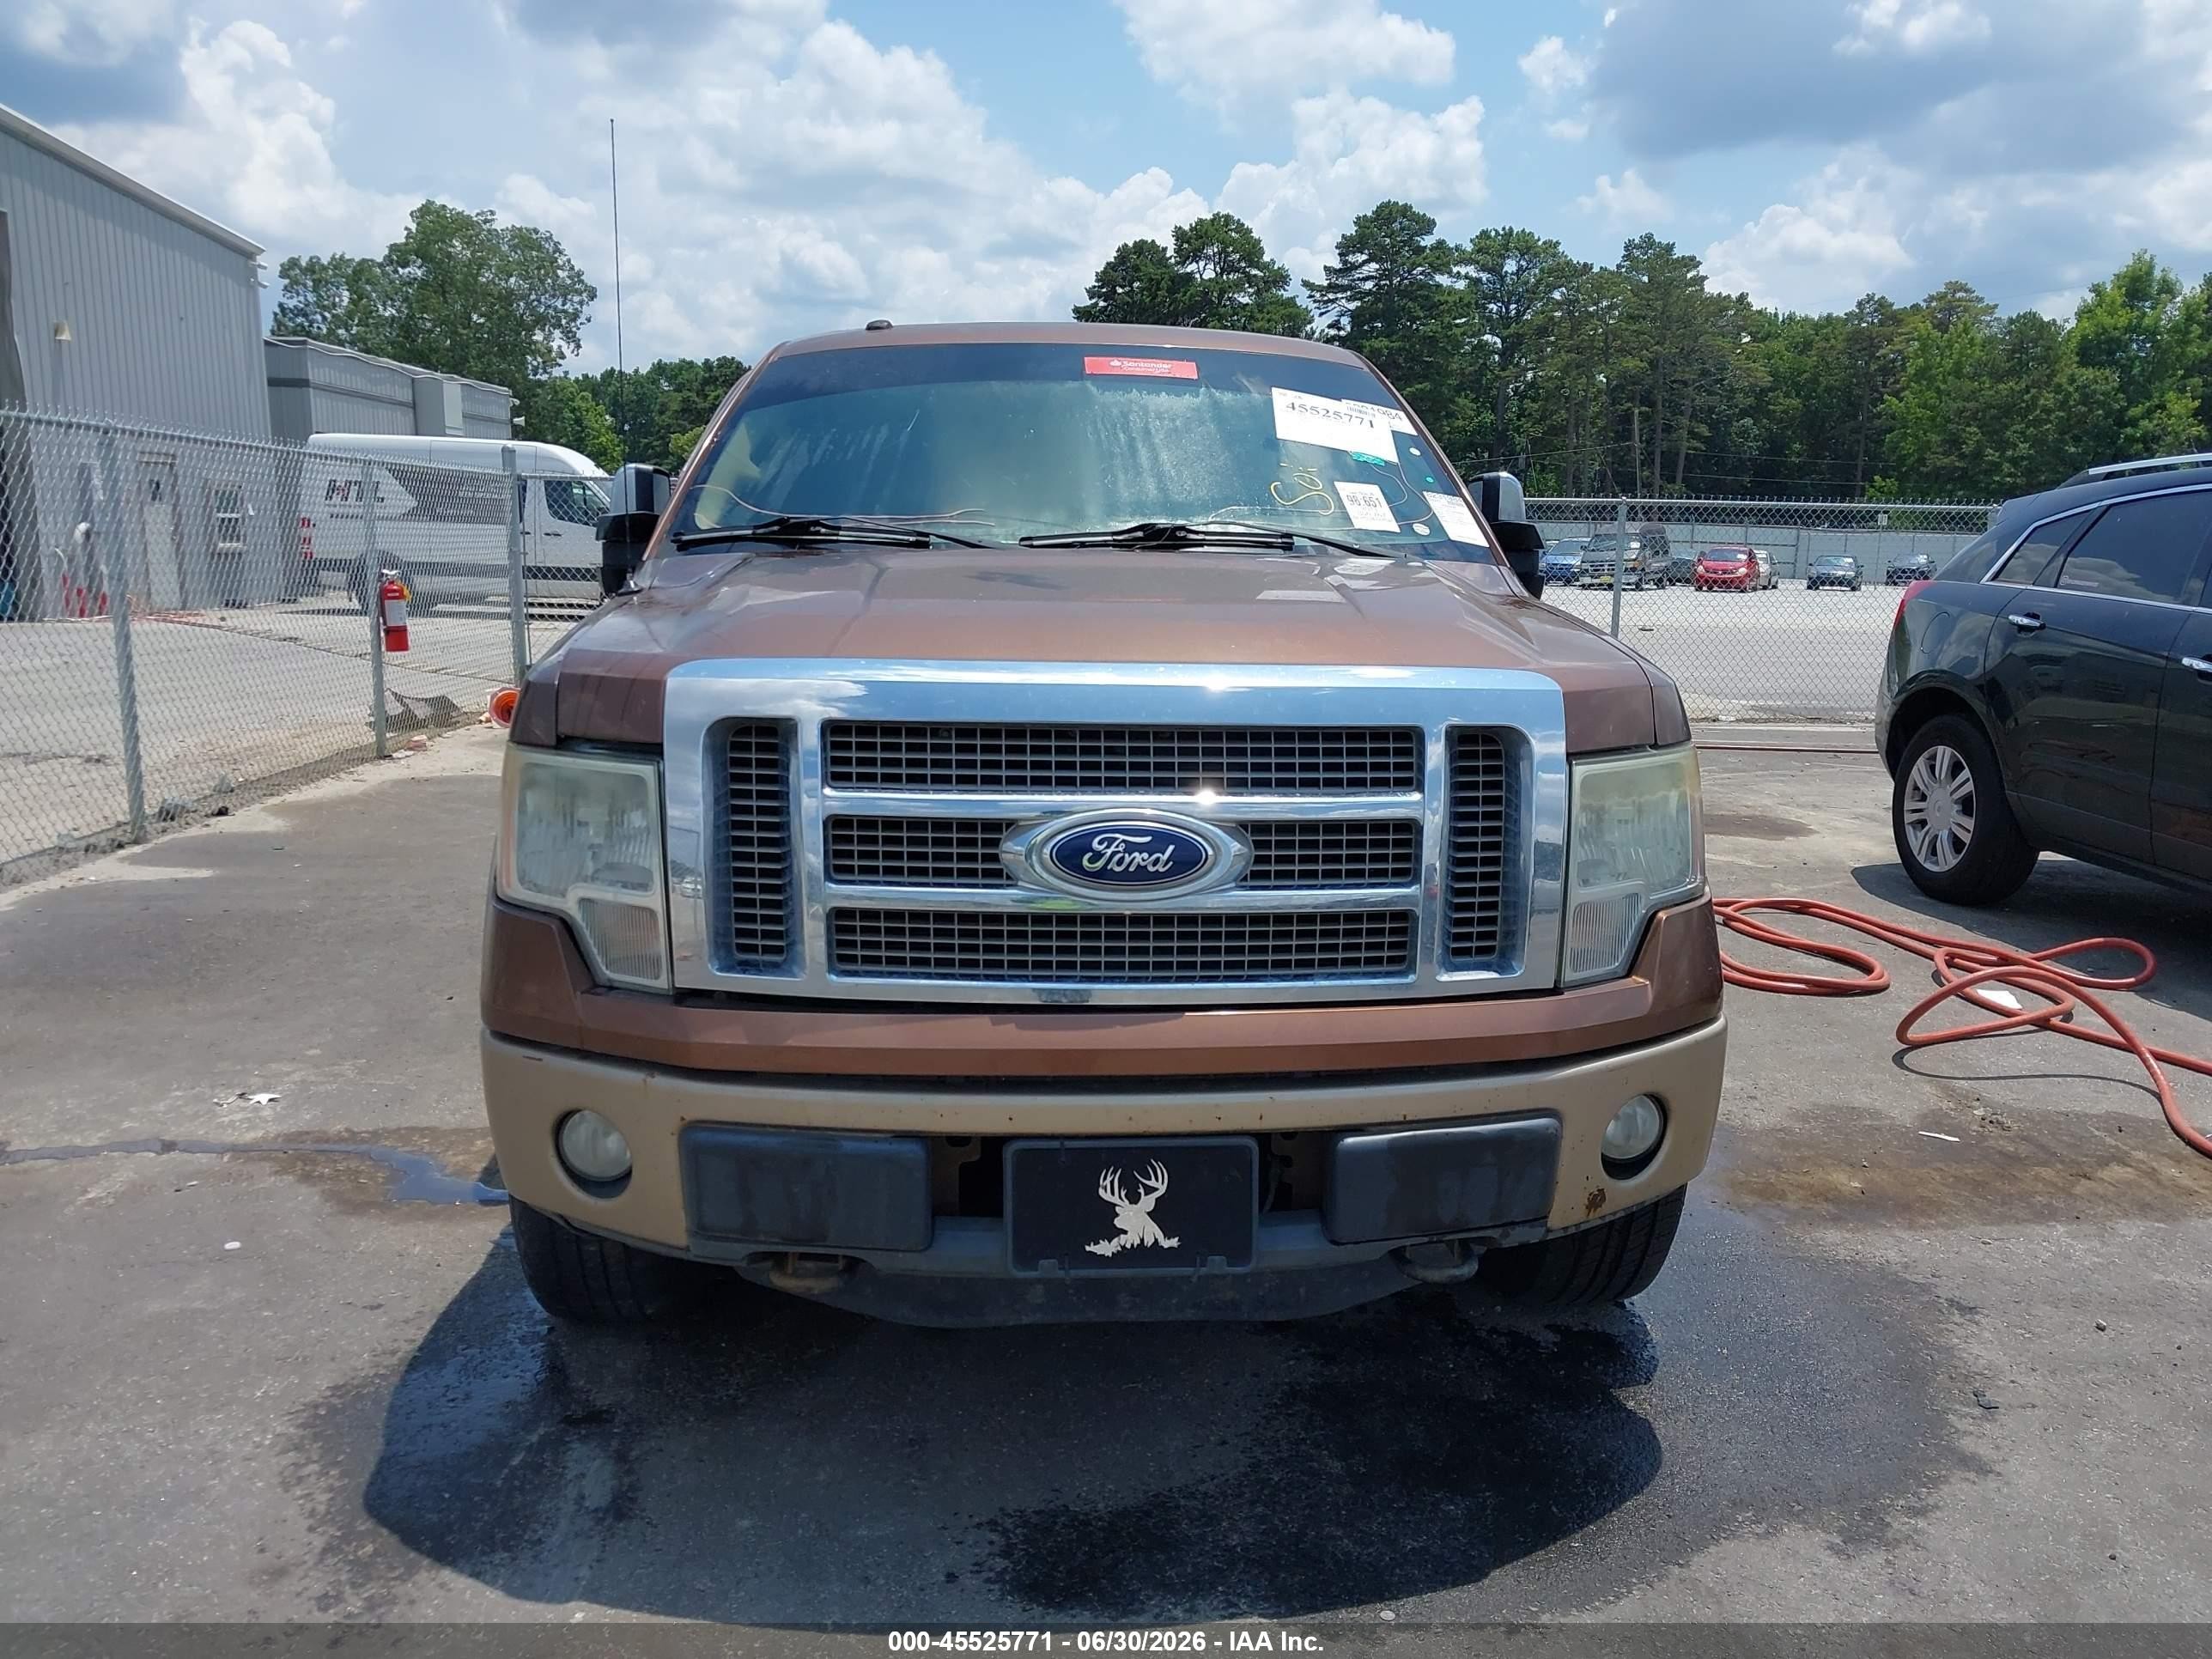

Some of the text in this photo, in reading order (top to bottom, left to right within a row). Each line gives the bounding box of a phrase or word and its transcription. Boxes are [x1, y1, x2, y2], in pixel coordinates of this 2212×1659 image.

[1121, 361, 1172, 369] Santander
[1286, 402, 1374, 428] 45525771
[1082, 833, 1176, 872] Ford
